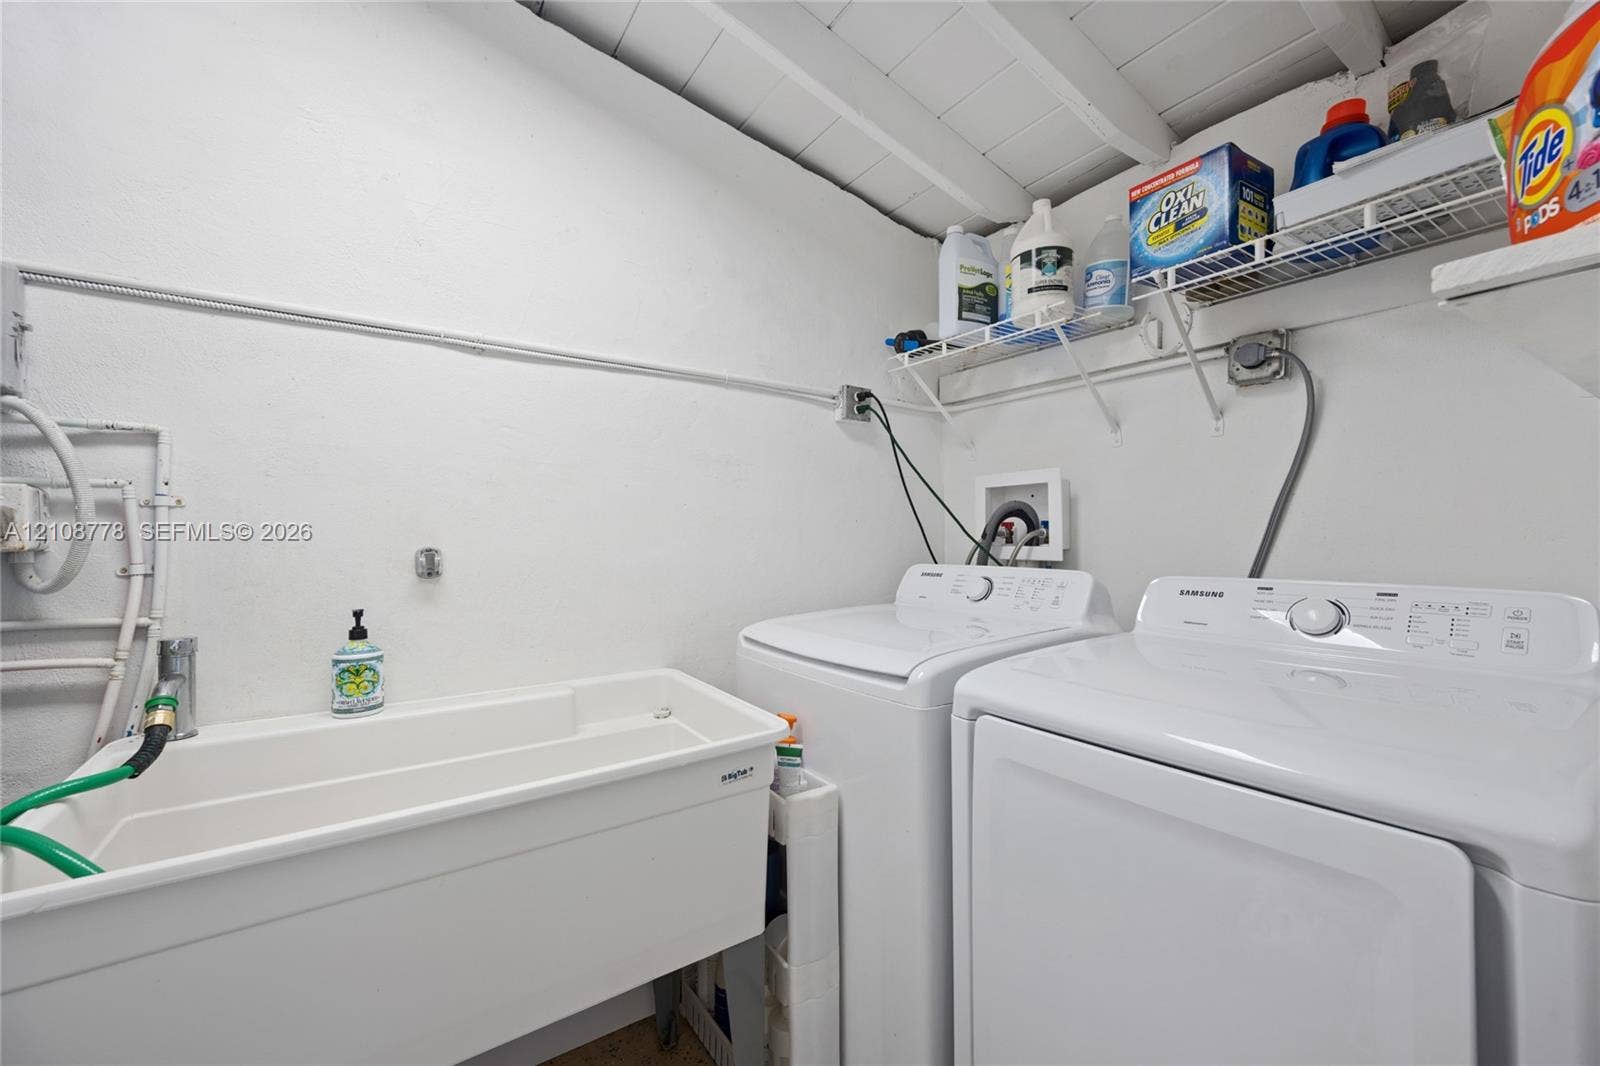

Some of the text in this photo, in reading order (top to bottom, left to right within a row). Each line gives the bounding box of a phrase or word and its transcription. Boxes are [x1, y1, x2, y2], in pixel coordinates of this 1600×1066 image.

[1142, 173, 1175, 192] CONCENTRATED
[1175, 161, 1199, 177] FORMULA
[1518, 126, 1568, 198] Tide
[1161, 182, 1194, 213] OXI
[1242, 186, 1254, 203] 101
[1148, 190, 1206, 234] CLEAN
[1523, 196, 1560, 235] PODS
[1179, 589, 1224, 598] SAMSUNG
